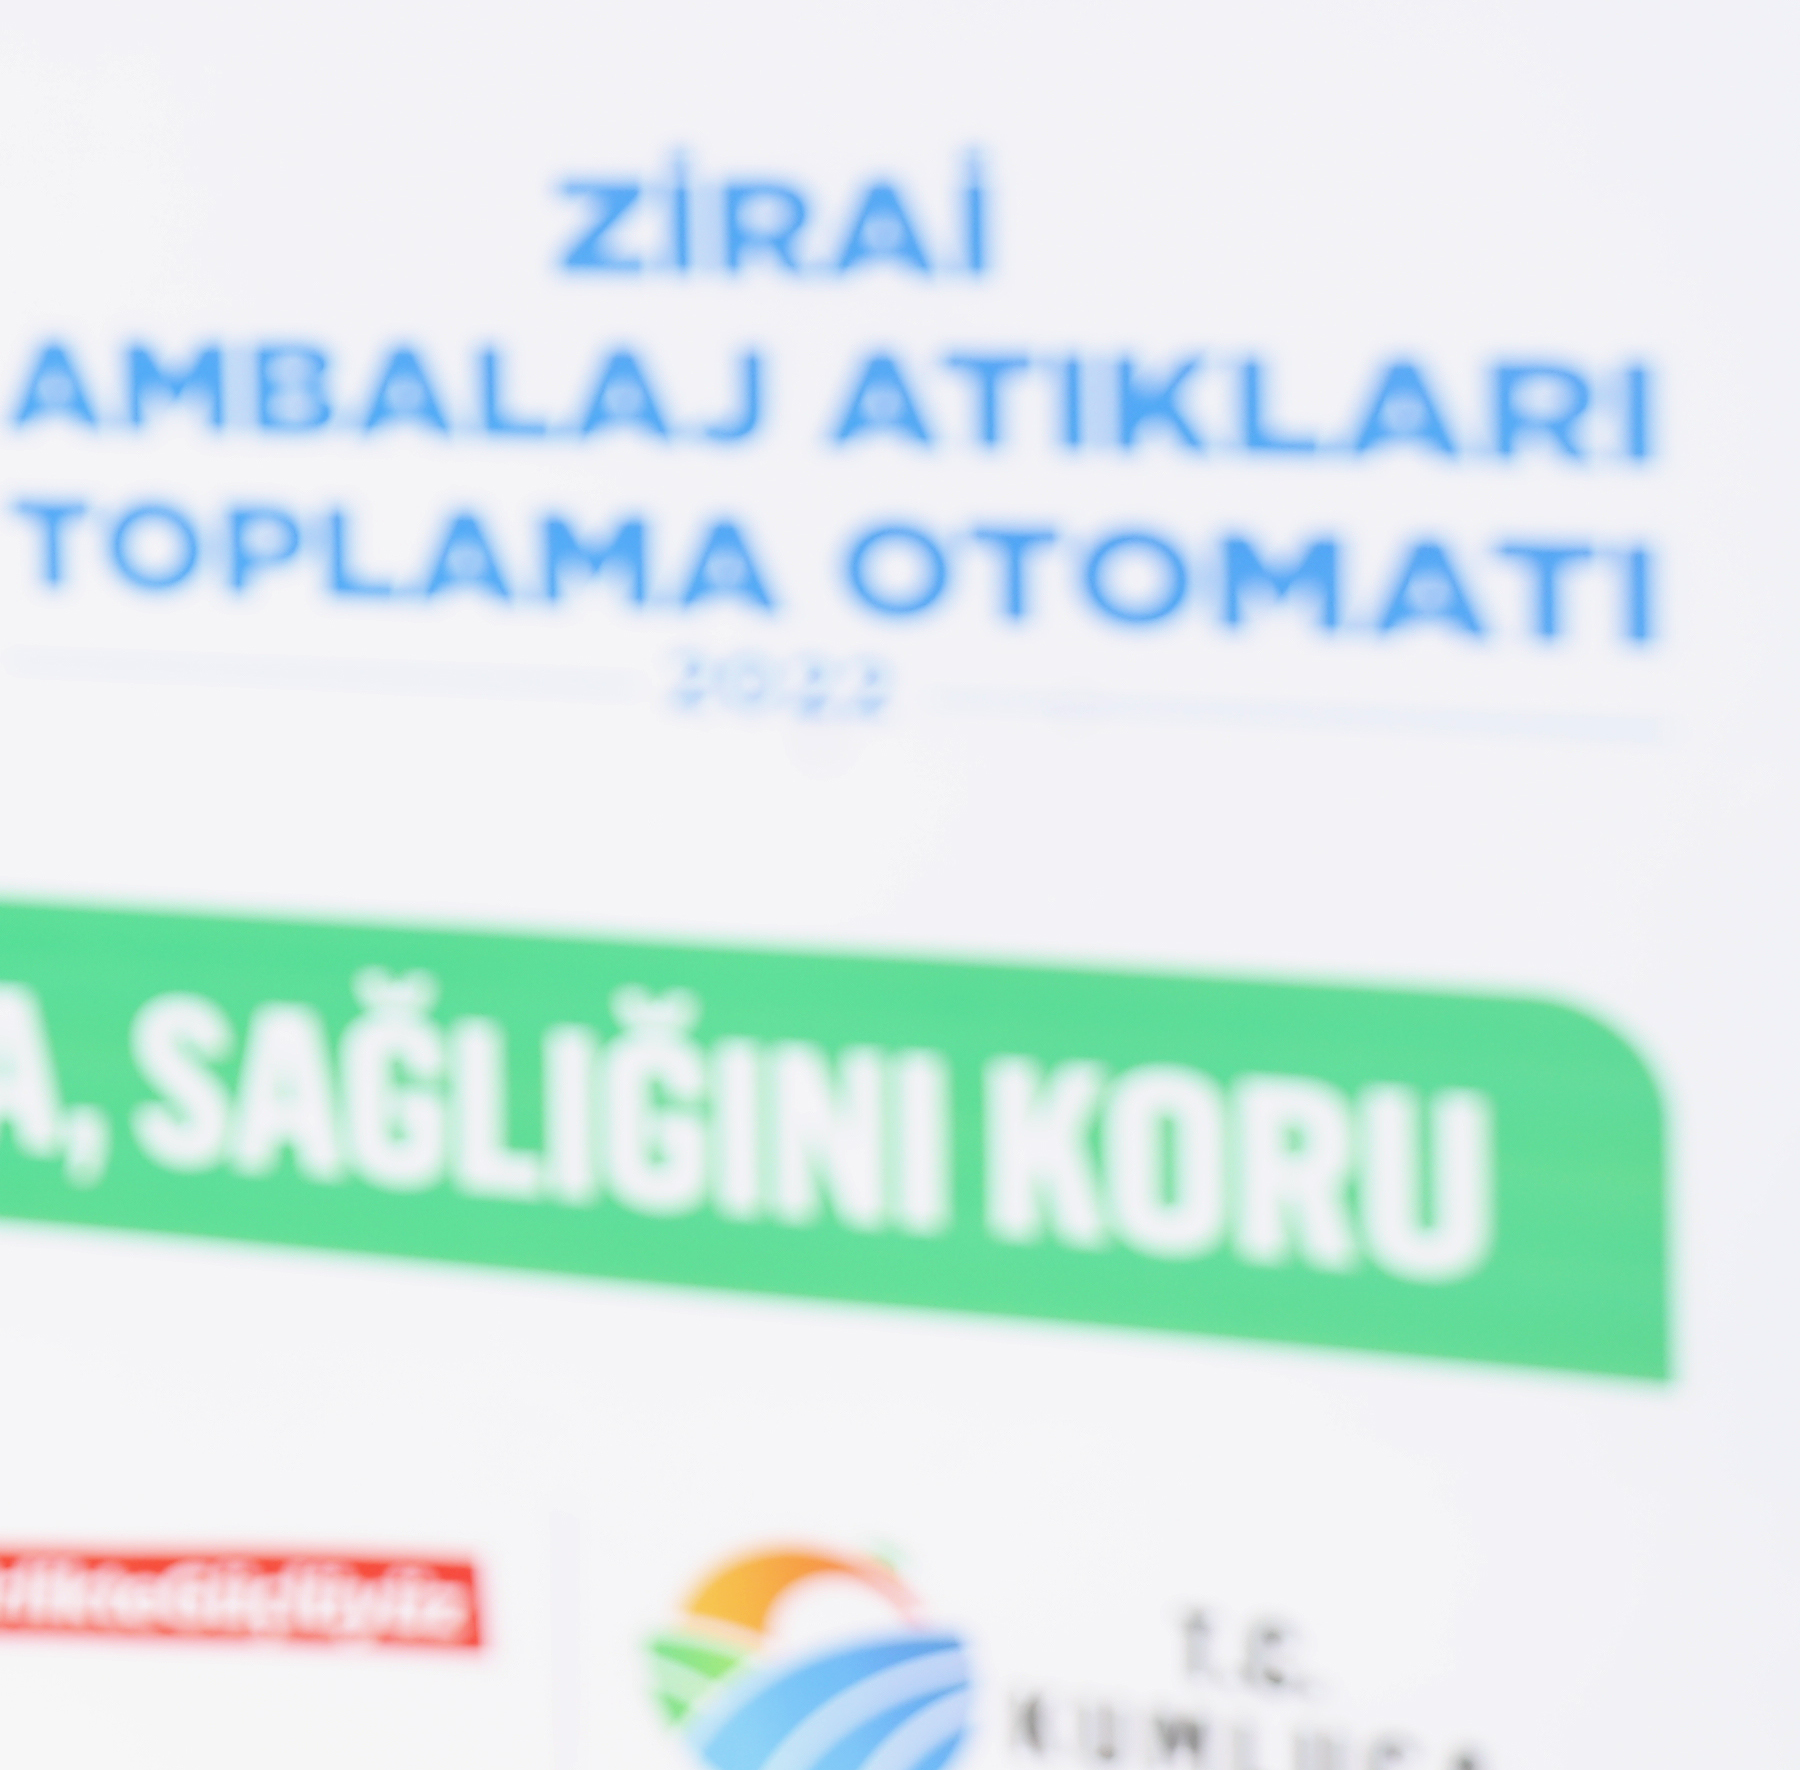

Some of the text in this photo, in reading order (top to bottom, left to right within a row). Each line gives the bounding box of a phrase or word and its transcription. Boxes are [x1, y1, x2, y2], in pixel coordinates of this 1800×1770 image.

[550, 142, 994, 282] ZİRAİ
[5, 330, 1656, 470] AMBALAJ ATIKLARI
[5, 490, 1658, 650] TOPLAMA OTOMATI
[128, 964, 956, 1240] SAĞLIĞINI
[978, 1050, 1498, 1286] KORU
